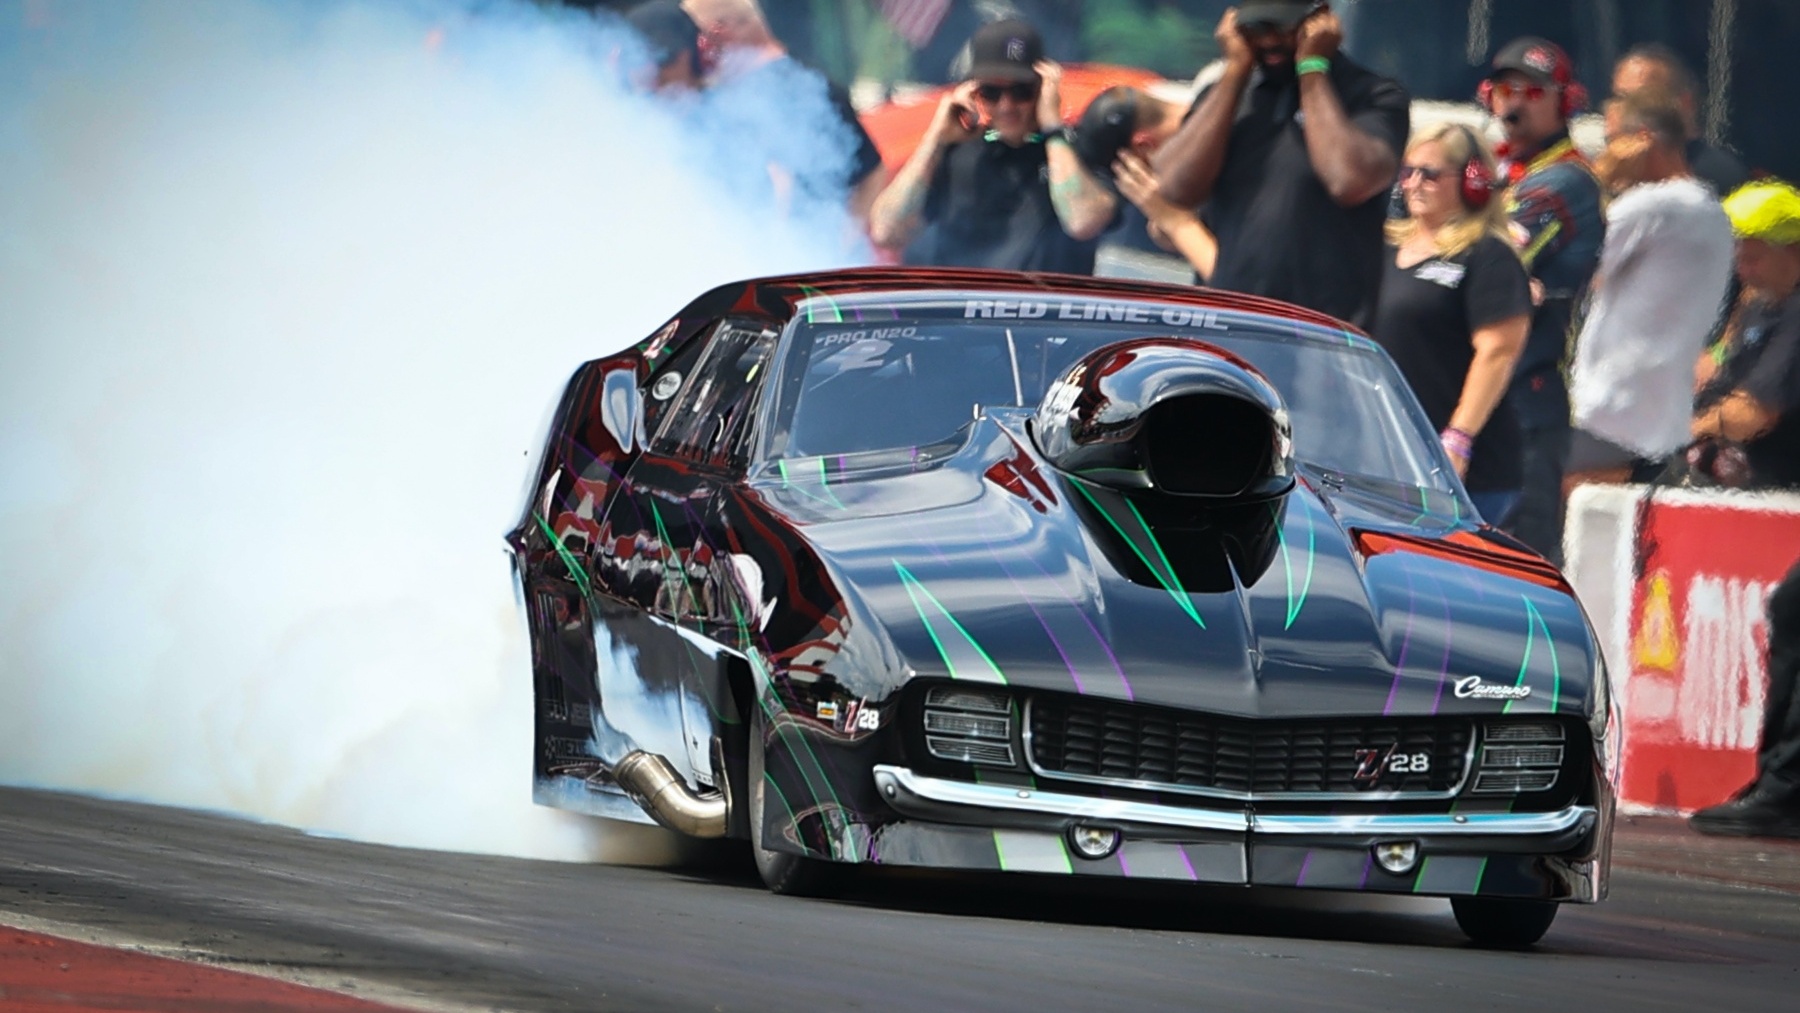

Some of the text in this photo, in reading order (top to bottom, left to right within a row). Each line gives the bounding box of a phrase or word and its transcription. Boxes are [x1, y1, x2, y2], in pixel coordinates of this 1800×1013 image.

[964, 300, 1228, 331] RED LINE OIL
[823, 331, 866, 346] PRO
[838, 339, 894, 371] 2
[1453, 675, 1531, 699] Camaro
